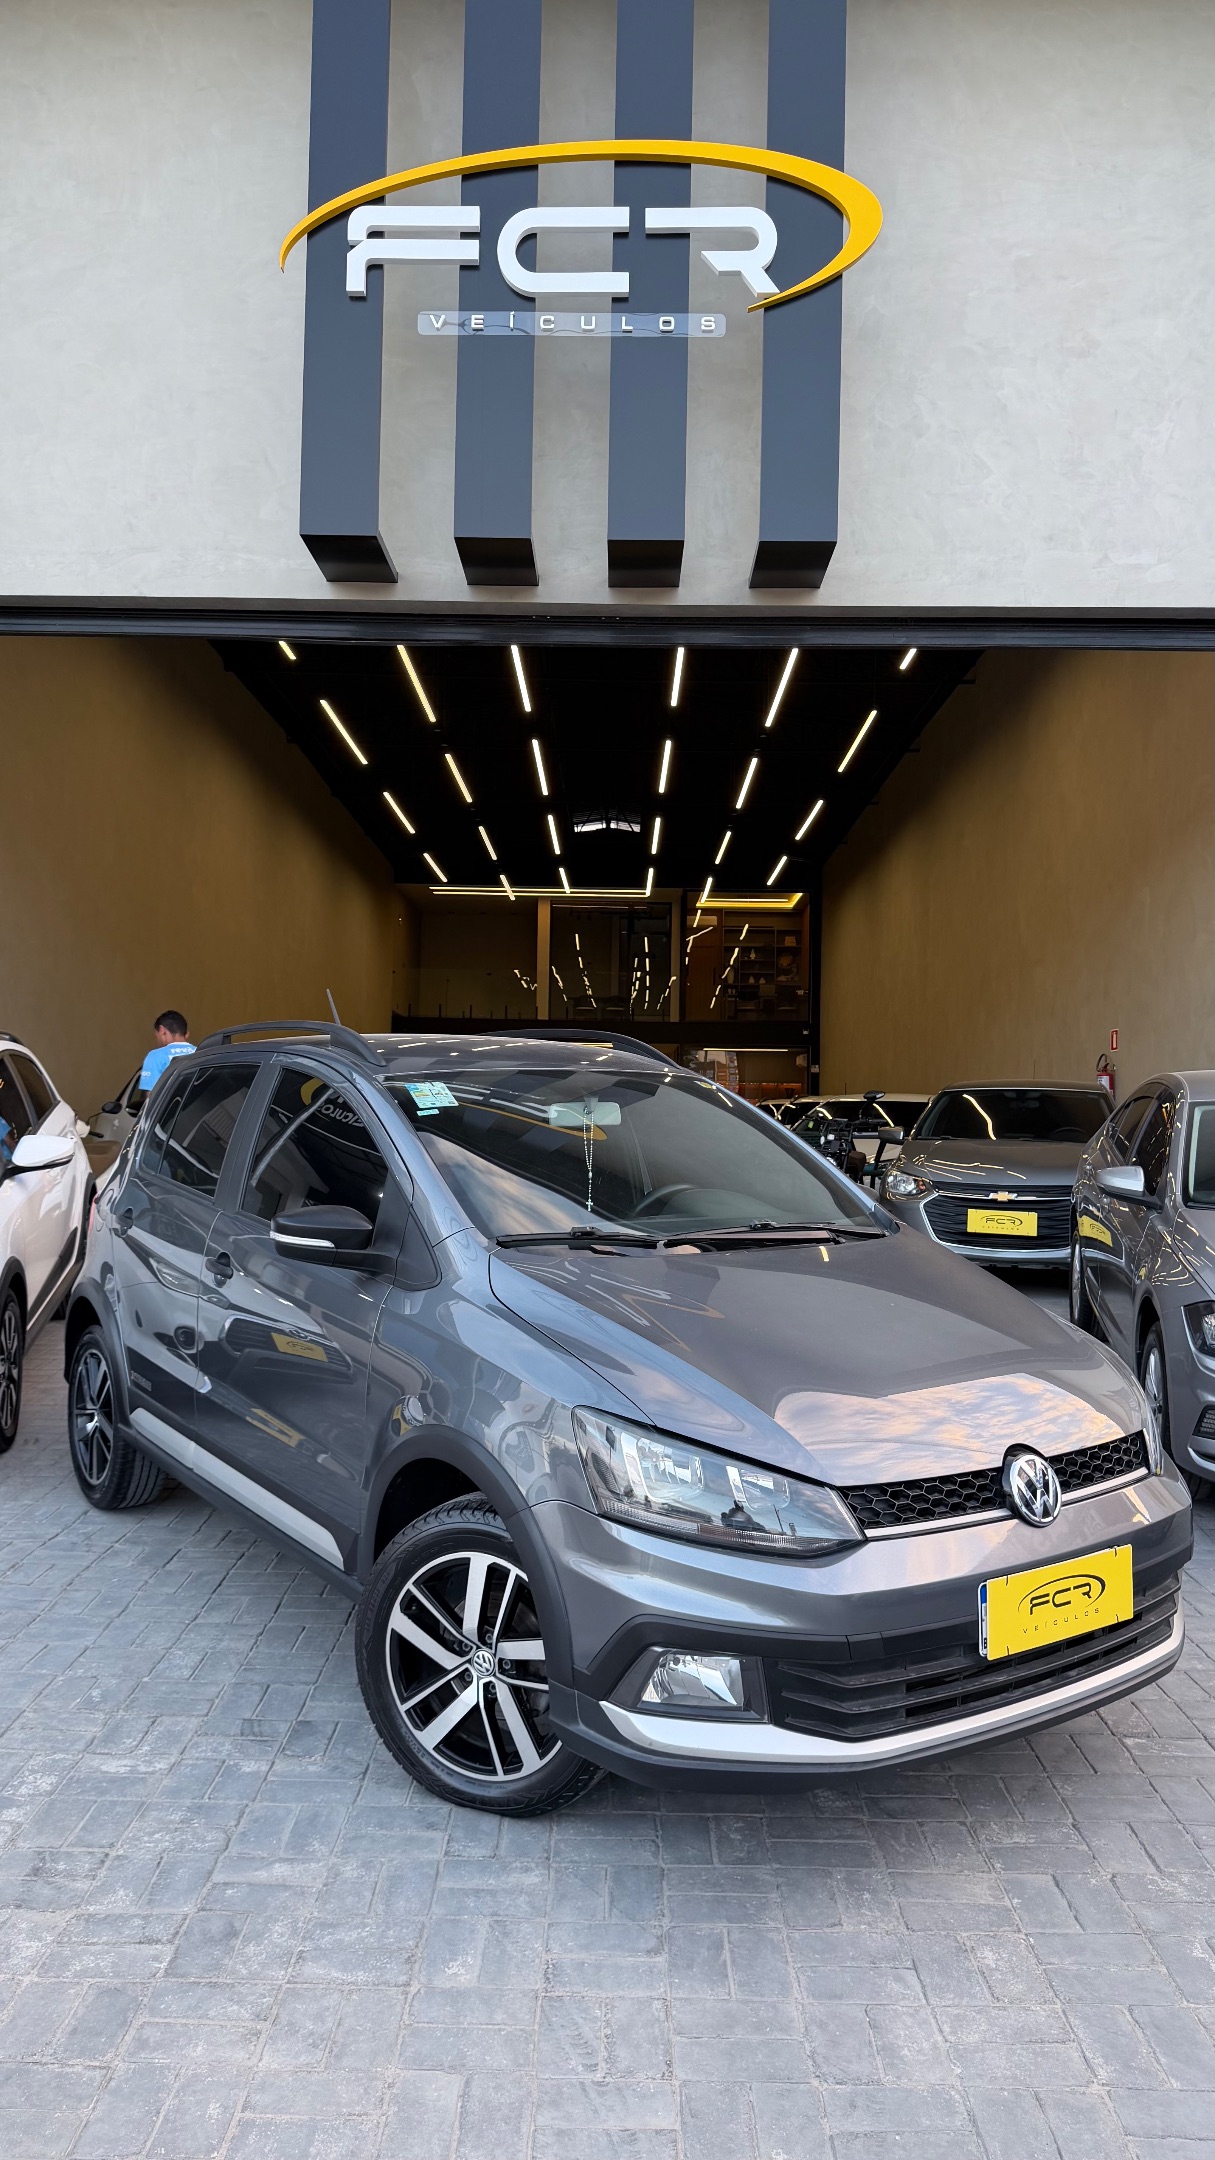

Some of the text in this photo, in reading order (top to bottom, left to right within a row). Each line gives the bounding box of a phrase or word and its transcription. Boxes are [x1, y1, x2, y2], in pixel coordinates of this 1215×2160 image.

[346, 205, 781, 297] FCR
[429, 310, 717, 333] VEÍCULOS
[1029, 1582, 1092, 1616] FCR
